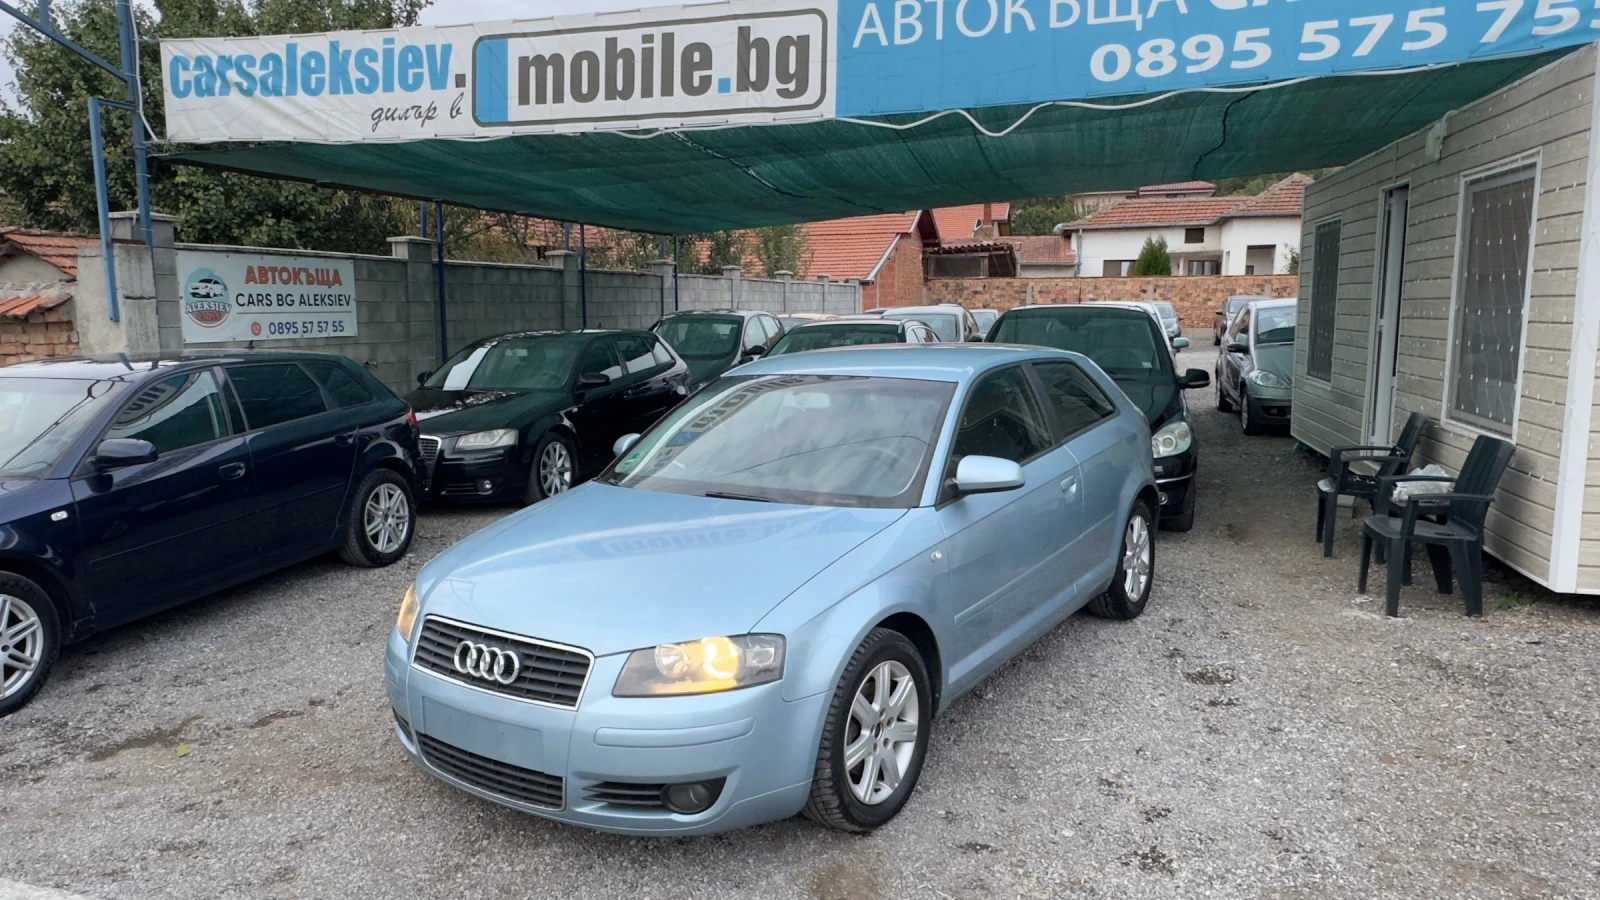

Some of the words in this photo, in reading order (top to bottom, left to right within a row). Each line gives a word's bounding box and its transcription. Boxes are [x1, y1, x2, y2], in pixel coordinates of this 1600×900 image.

[1090, 27, 1273, 82] 0895
[1297, 6, 1448, 61] 575
[1476, 0, 1600, 43] 75
[518, 26, 810, 106] mobile.bg
[244, 265, 342, 289] АВТОКЪЩА
[185, 300, 232, 314] ALEKSIEV
[235, 293, 273, 307] CARS
[276, 293, 295, 307] BG
[299, 293, 351, 307] ALEKSIEV
[268, 322, 299, 335] 0895
[302, 321, 314, 334] 57
[317, 321, 329, 333] 57
[332, 320, 345, 333] 55
